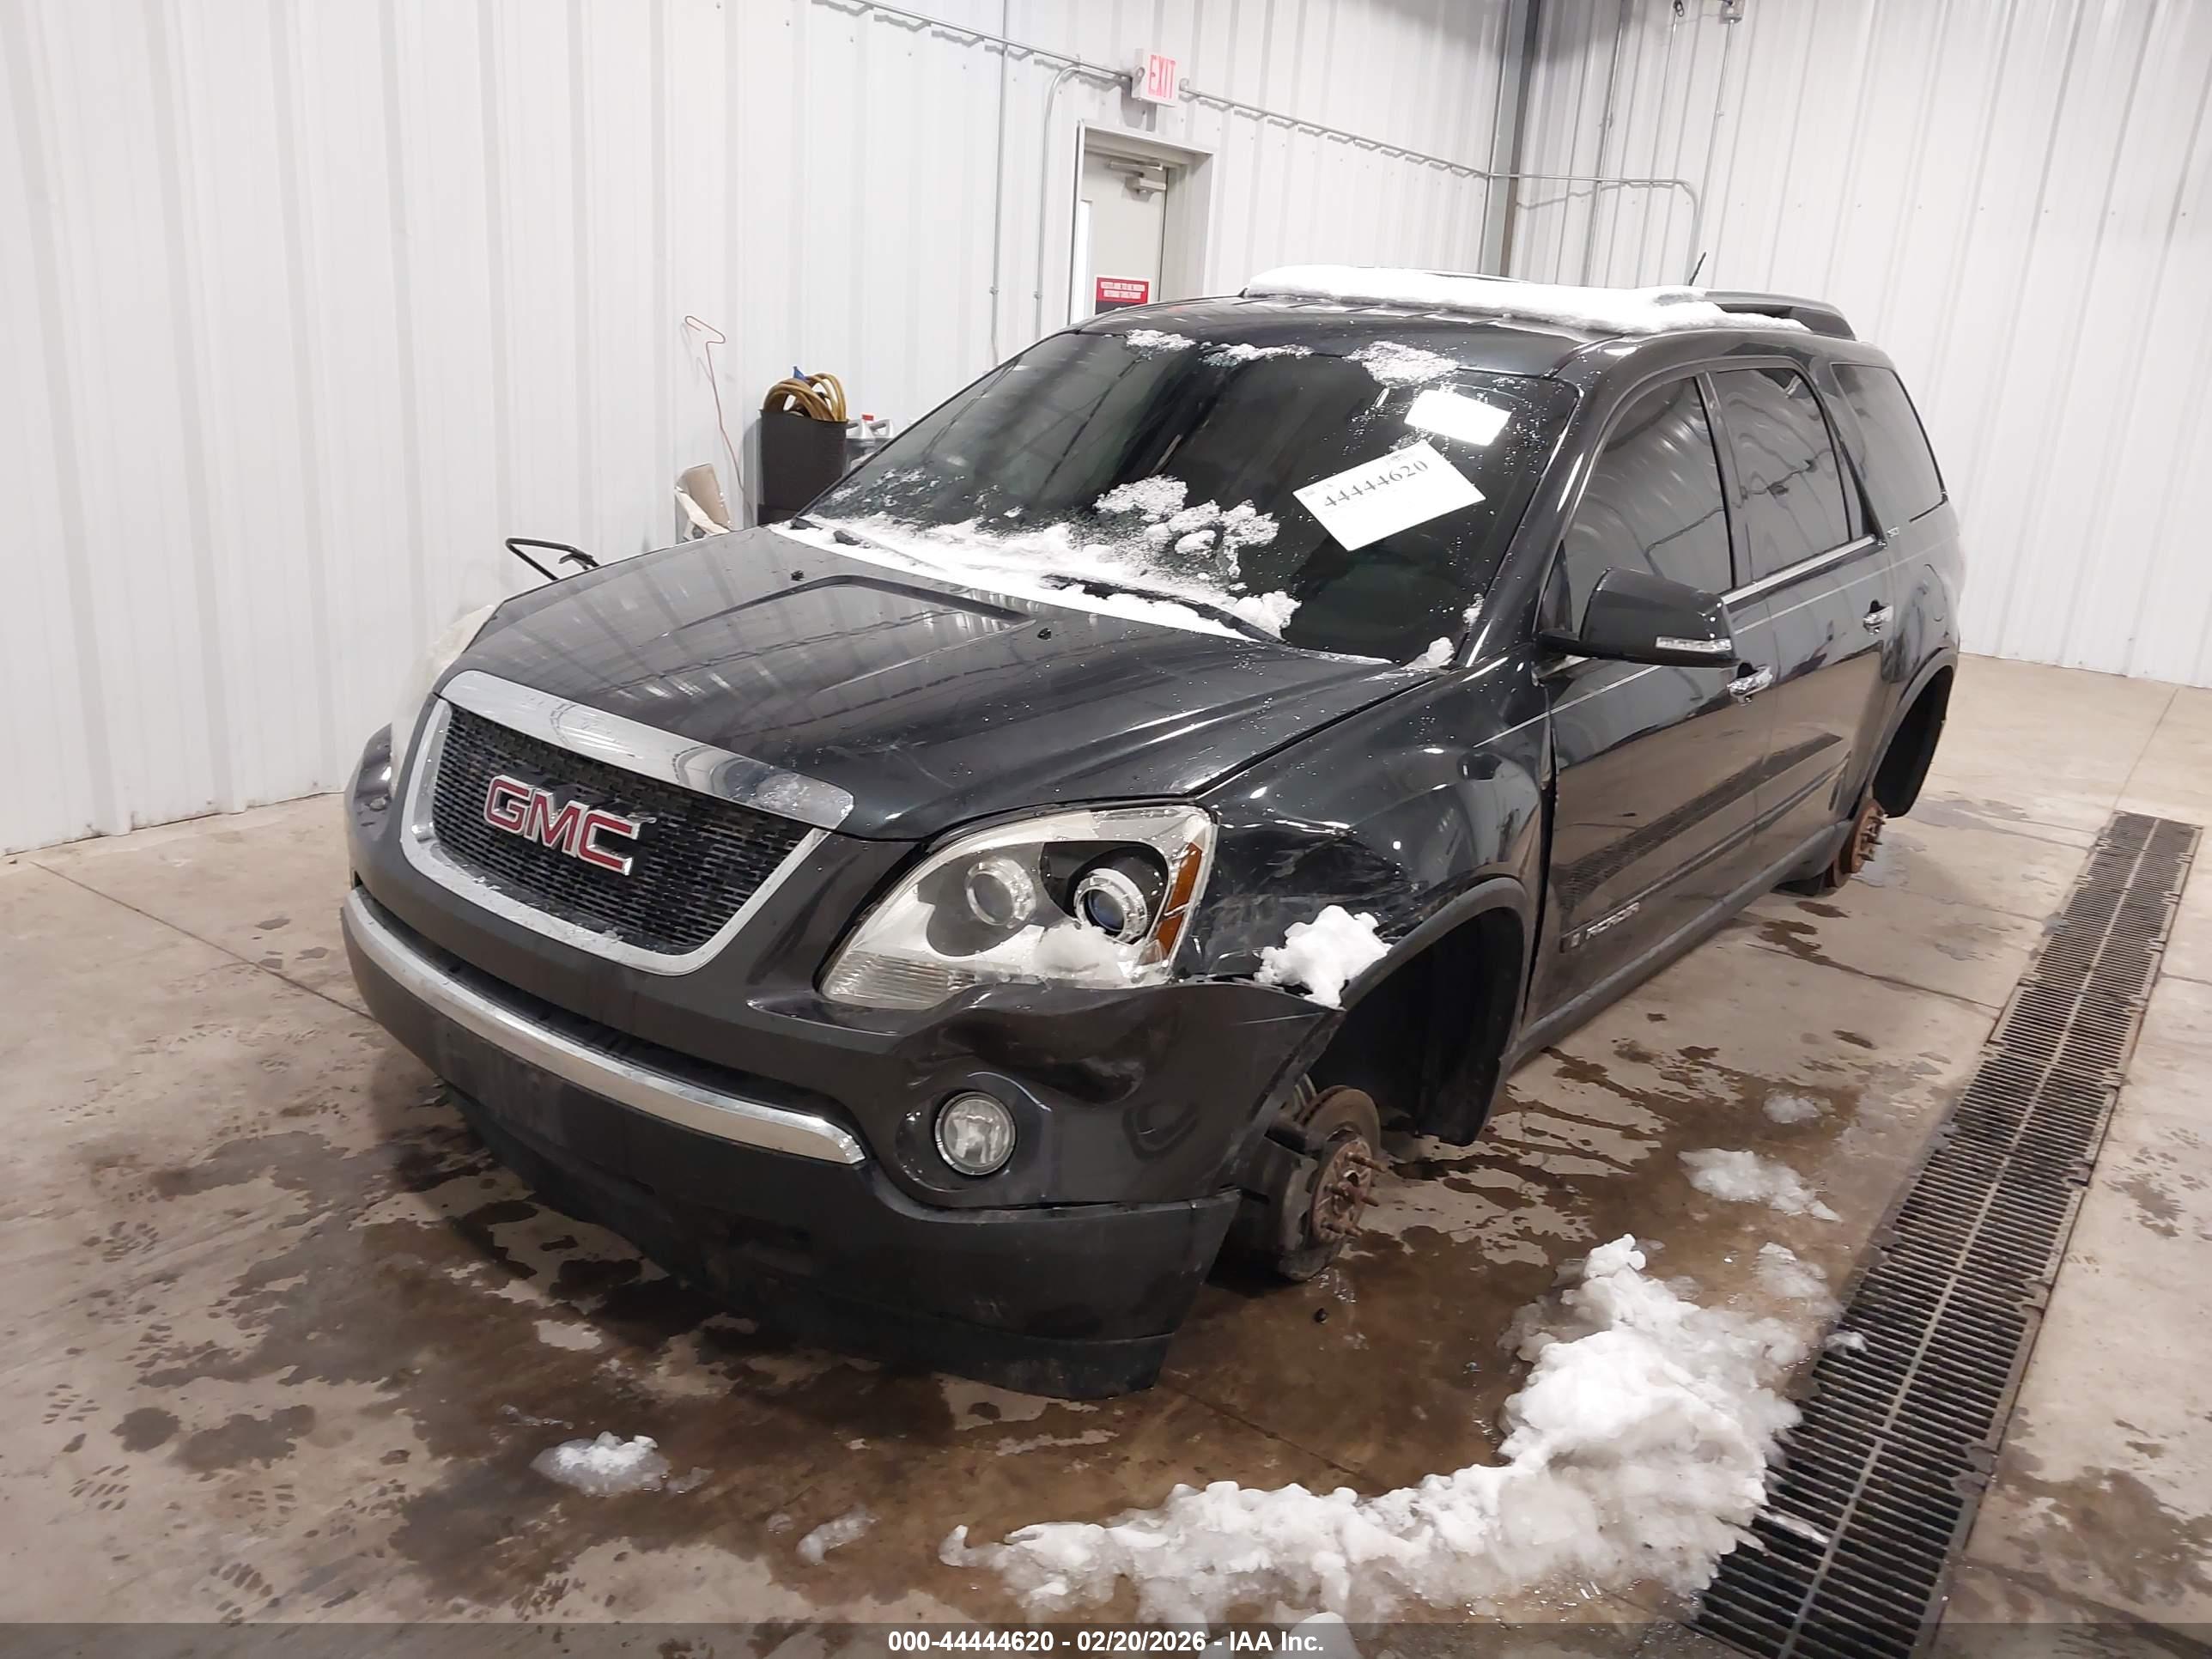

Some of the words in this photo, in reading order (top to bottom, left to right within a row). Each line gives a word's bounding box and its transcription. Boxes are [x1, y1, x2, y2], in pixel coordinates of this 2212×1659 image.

[1148, 54, 1176, 99] EXIT
[1324, 460, 1428, 507] 44444620
[484, 775, 641, 876] GMC
